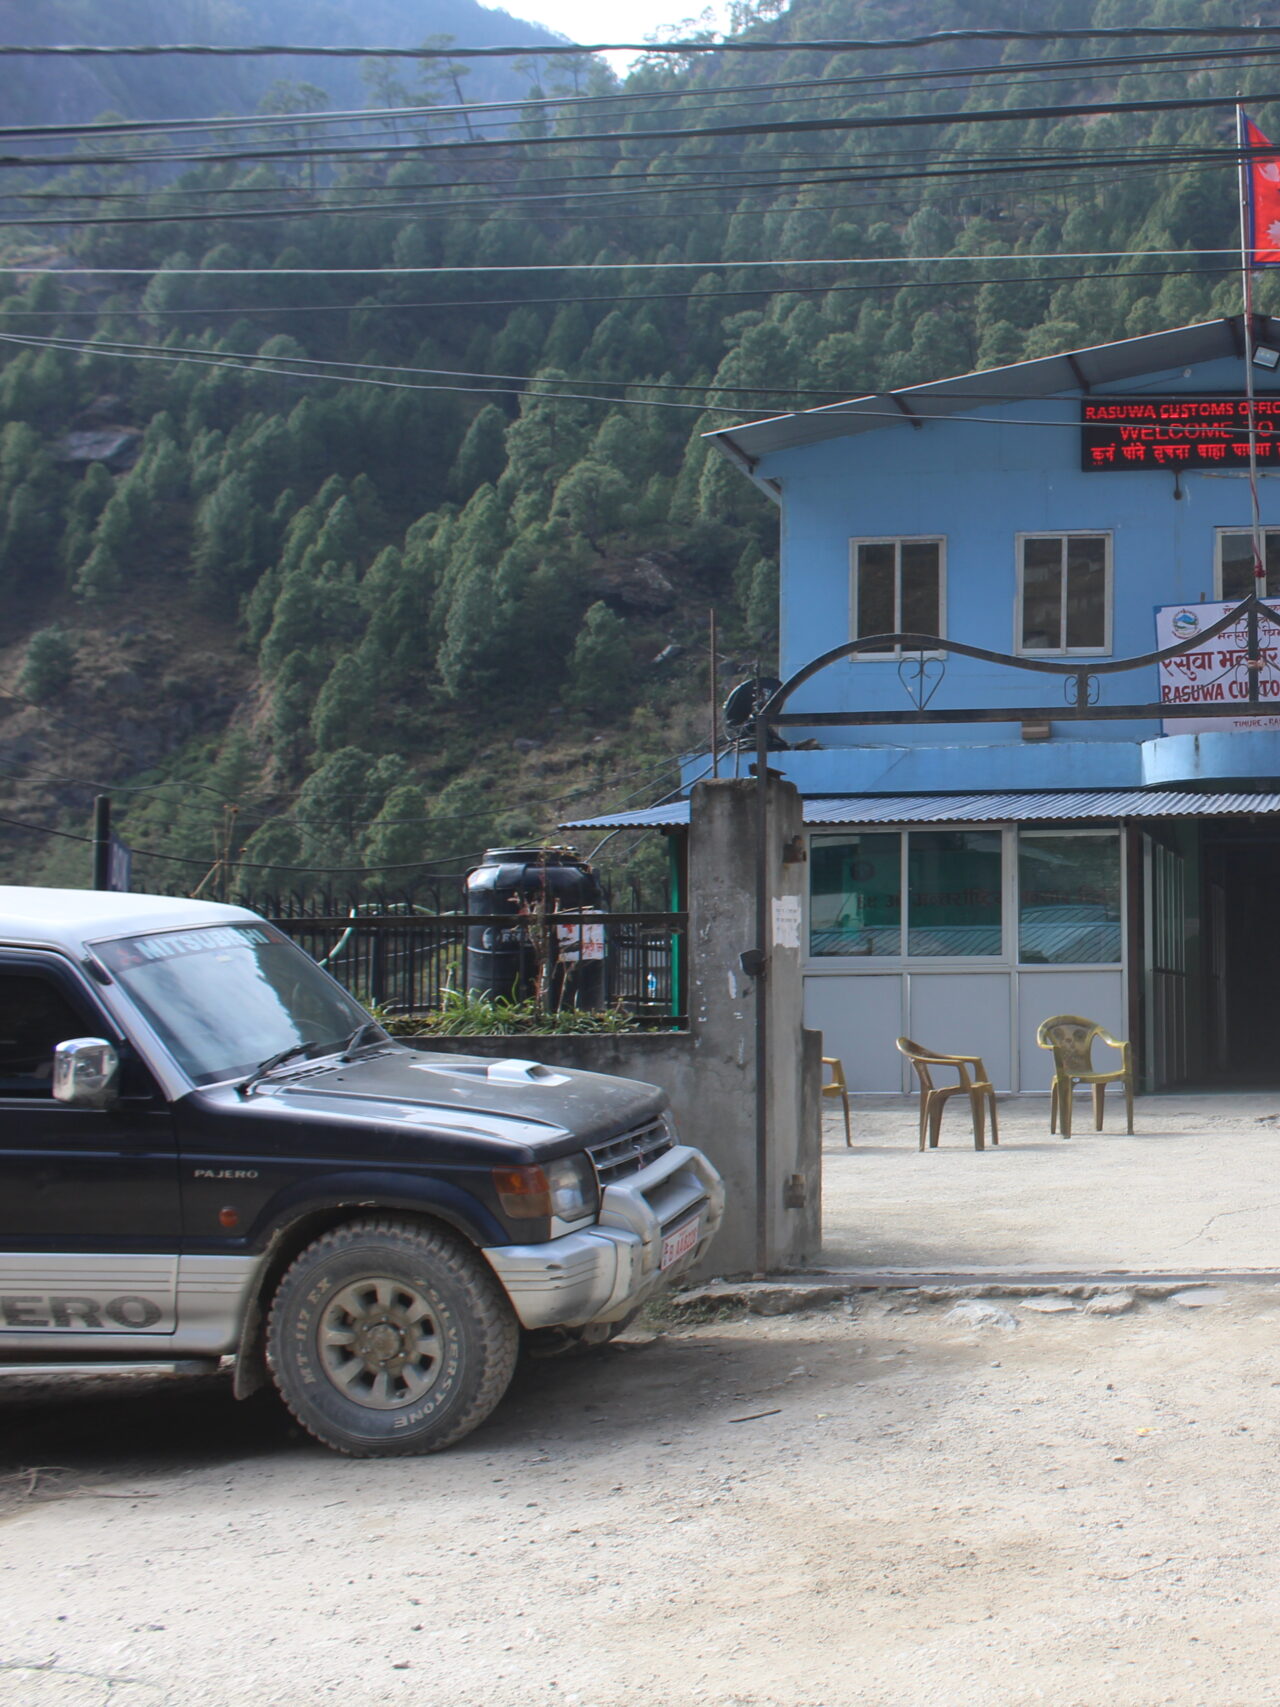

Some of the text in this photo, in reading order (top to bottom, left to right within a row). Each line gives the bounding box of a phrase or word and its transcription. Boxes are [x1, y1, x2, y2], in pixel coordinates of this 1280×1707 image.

[1086, 405, 1156, 419] RASUWA
[1159, 402, 1234, 418] CUSTOMS
[1120, 421, 1234, 440] WELCOME
[1162, 681, 1224, 703] RASUWA
[134, 928, 270, 960] MITSUBISHI
[194, 1169, 258, 1179] PAJERO
[0, 1295, 163, 1329] ERO
